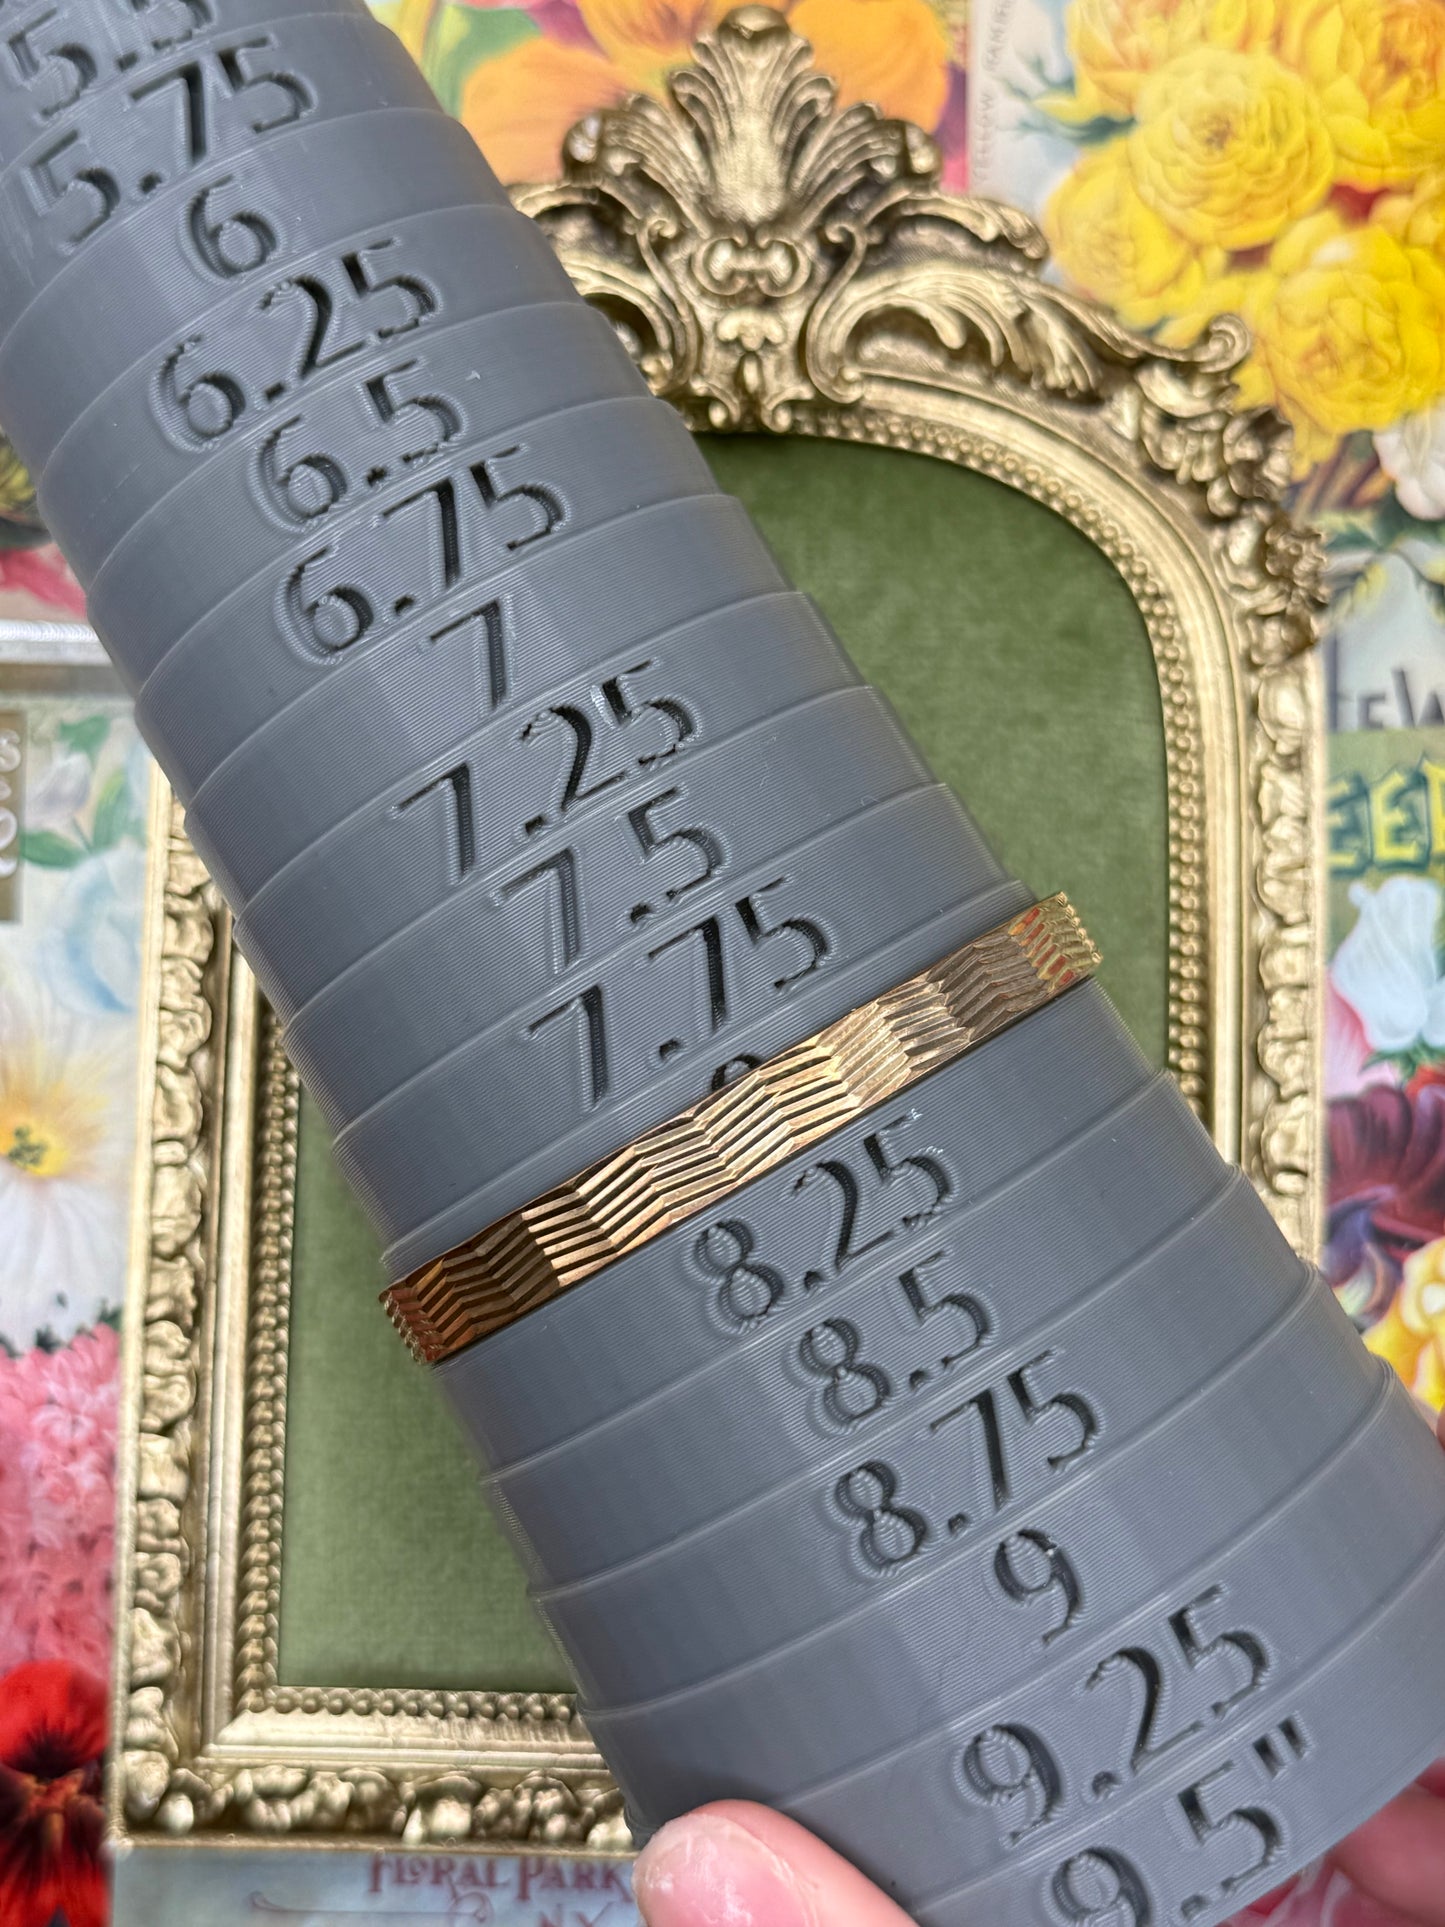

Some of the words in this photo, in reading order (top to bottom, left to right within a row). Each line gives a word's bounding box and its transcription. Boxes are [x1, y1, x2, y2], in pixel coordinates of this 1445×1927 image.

[22, 35, 316, 254] 5.75
[180, 173, 281, 282] 6
[150, 239, 441, 453] 6.25
[252, 357, 467, 532] 6.5
[275, 444, 570, 665] 6.75
[423, 596, 514, 716] 7
[389, 658, 701, 884] 7.25
[490, 785, 732, 974] 7.5
[522, 874, 838, 1110] 7.75
[684, 1108, 959, 1336] 8.25
[788, 1249, 999, 1438] 8.5
[826, 1346, 1105, 1577] 8.75
[990, 1527, 1086, 1648] 9
[953, 1581, 1277, 1847] 9.25
[368, 1854, 509, 1894] FLORAL
[516, 1855, 633, 1902] PARK
